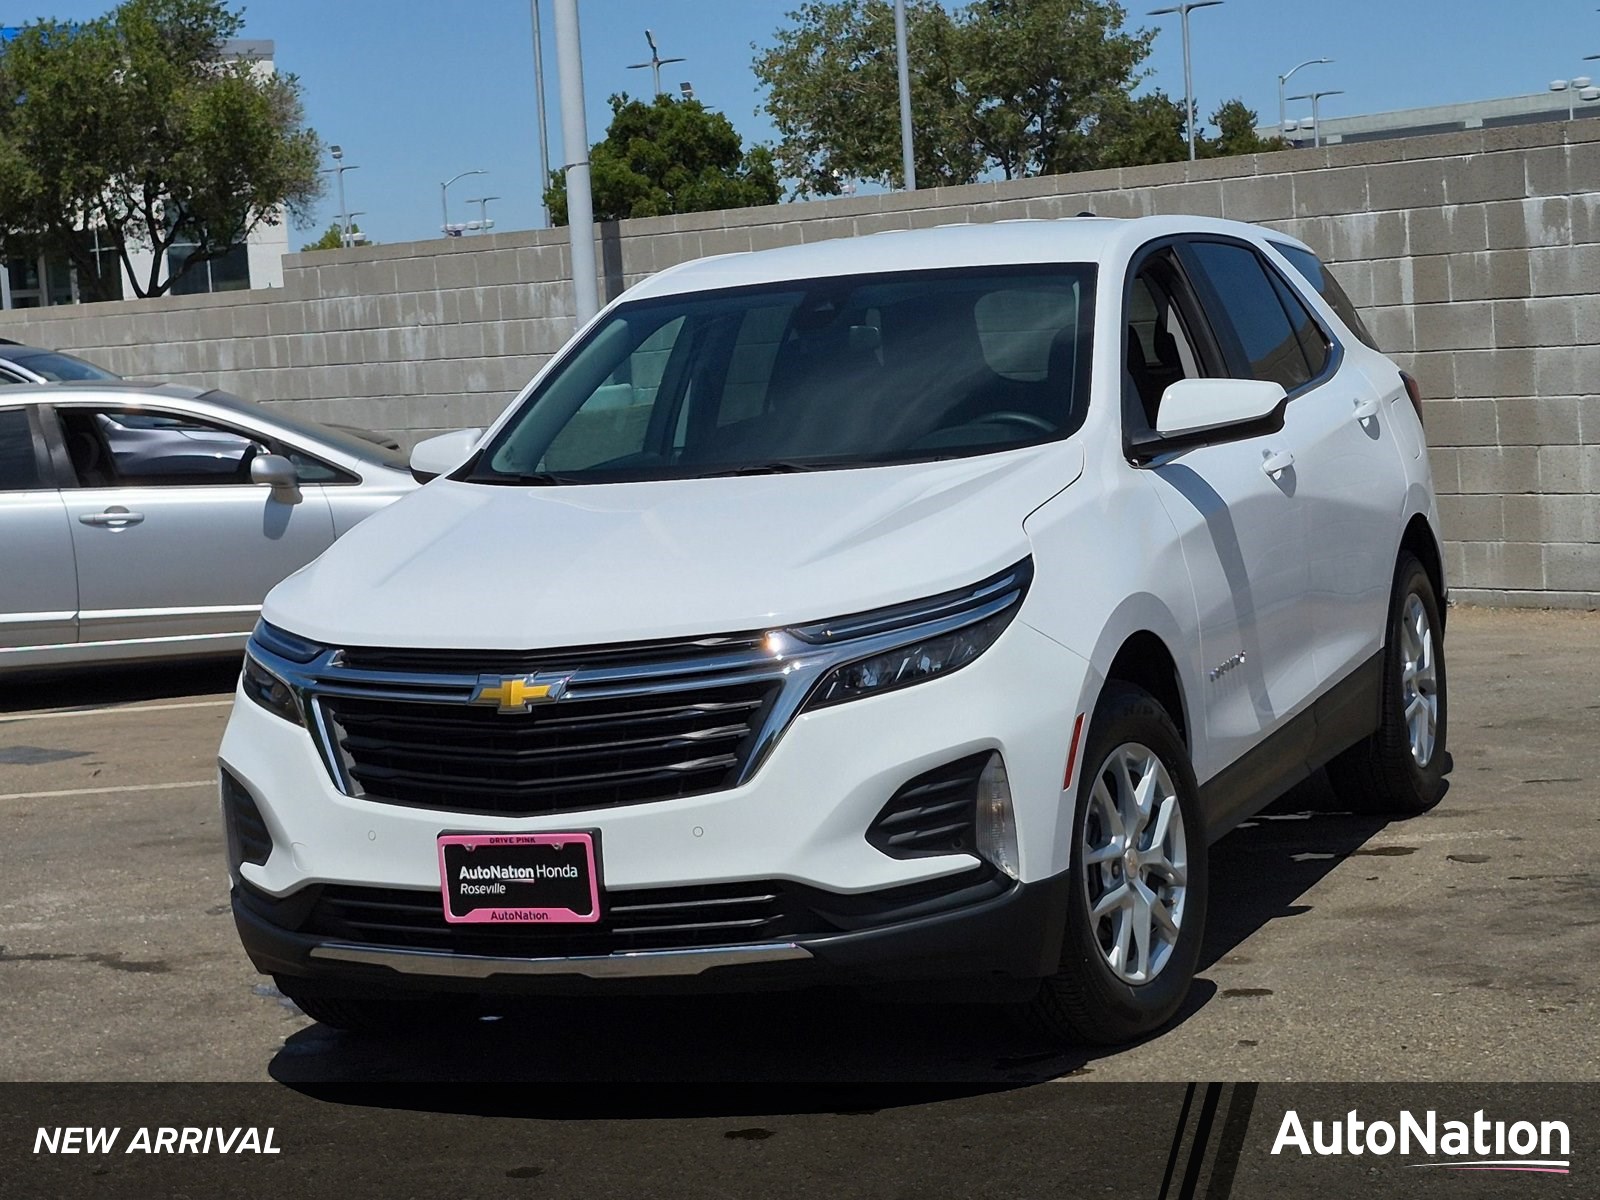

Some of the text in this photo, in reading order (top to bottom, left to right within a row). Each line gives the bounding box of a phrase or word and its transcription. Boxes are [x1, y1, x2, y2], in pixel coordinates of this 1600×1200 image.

[516, 836, 536, 844] PINK
[459, 864, 578, 880] AutoNation Honda
[460, 883, 506, 895] Roseville
[490, 911, 549, 921] AutoNation
